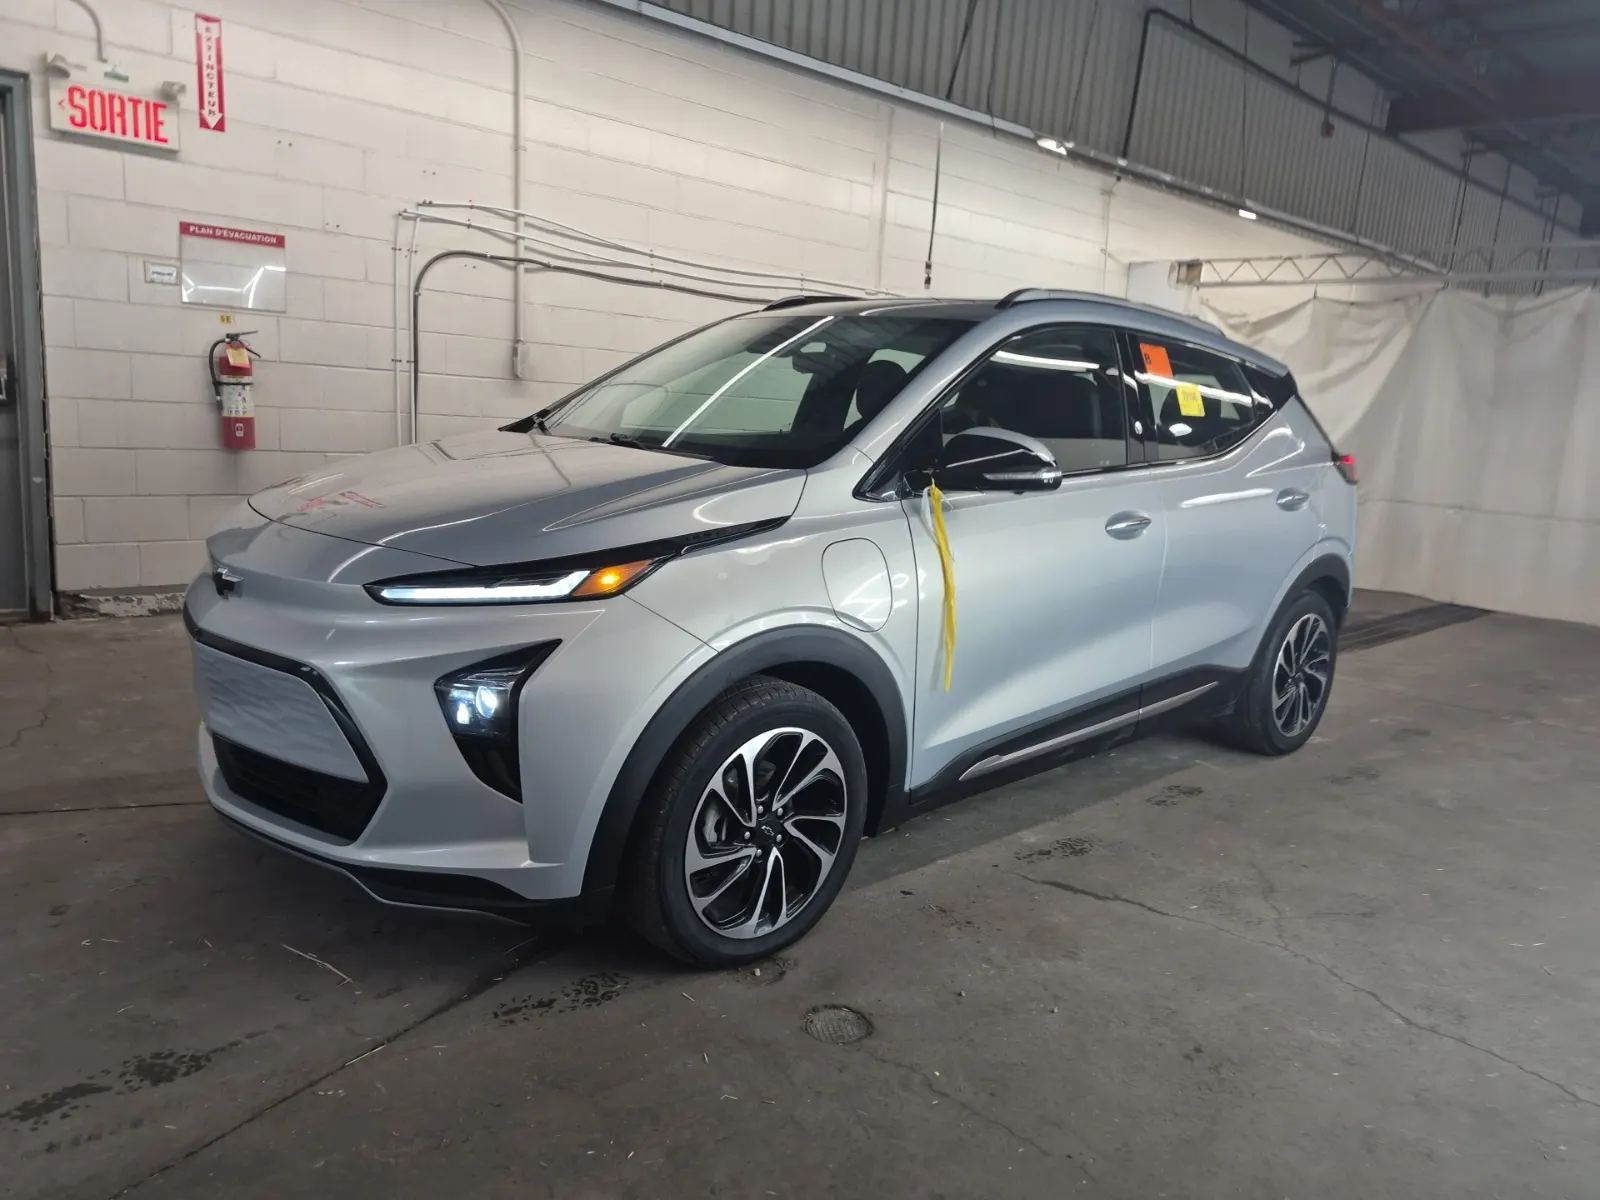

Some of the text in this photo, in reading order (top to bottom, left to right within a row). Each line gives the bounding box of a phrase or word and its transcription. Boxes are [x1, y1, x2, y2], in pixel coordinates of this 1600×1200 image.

[205, 26, 216, 116] EXTINCTEUR
[67, 85, 169, 143] SORTIE
[189, 225, 214, 235] PLAN
